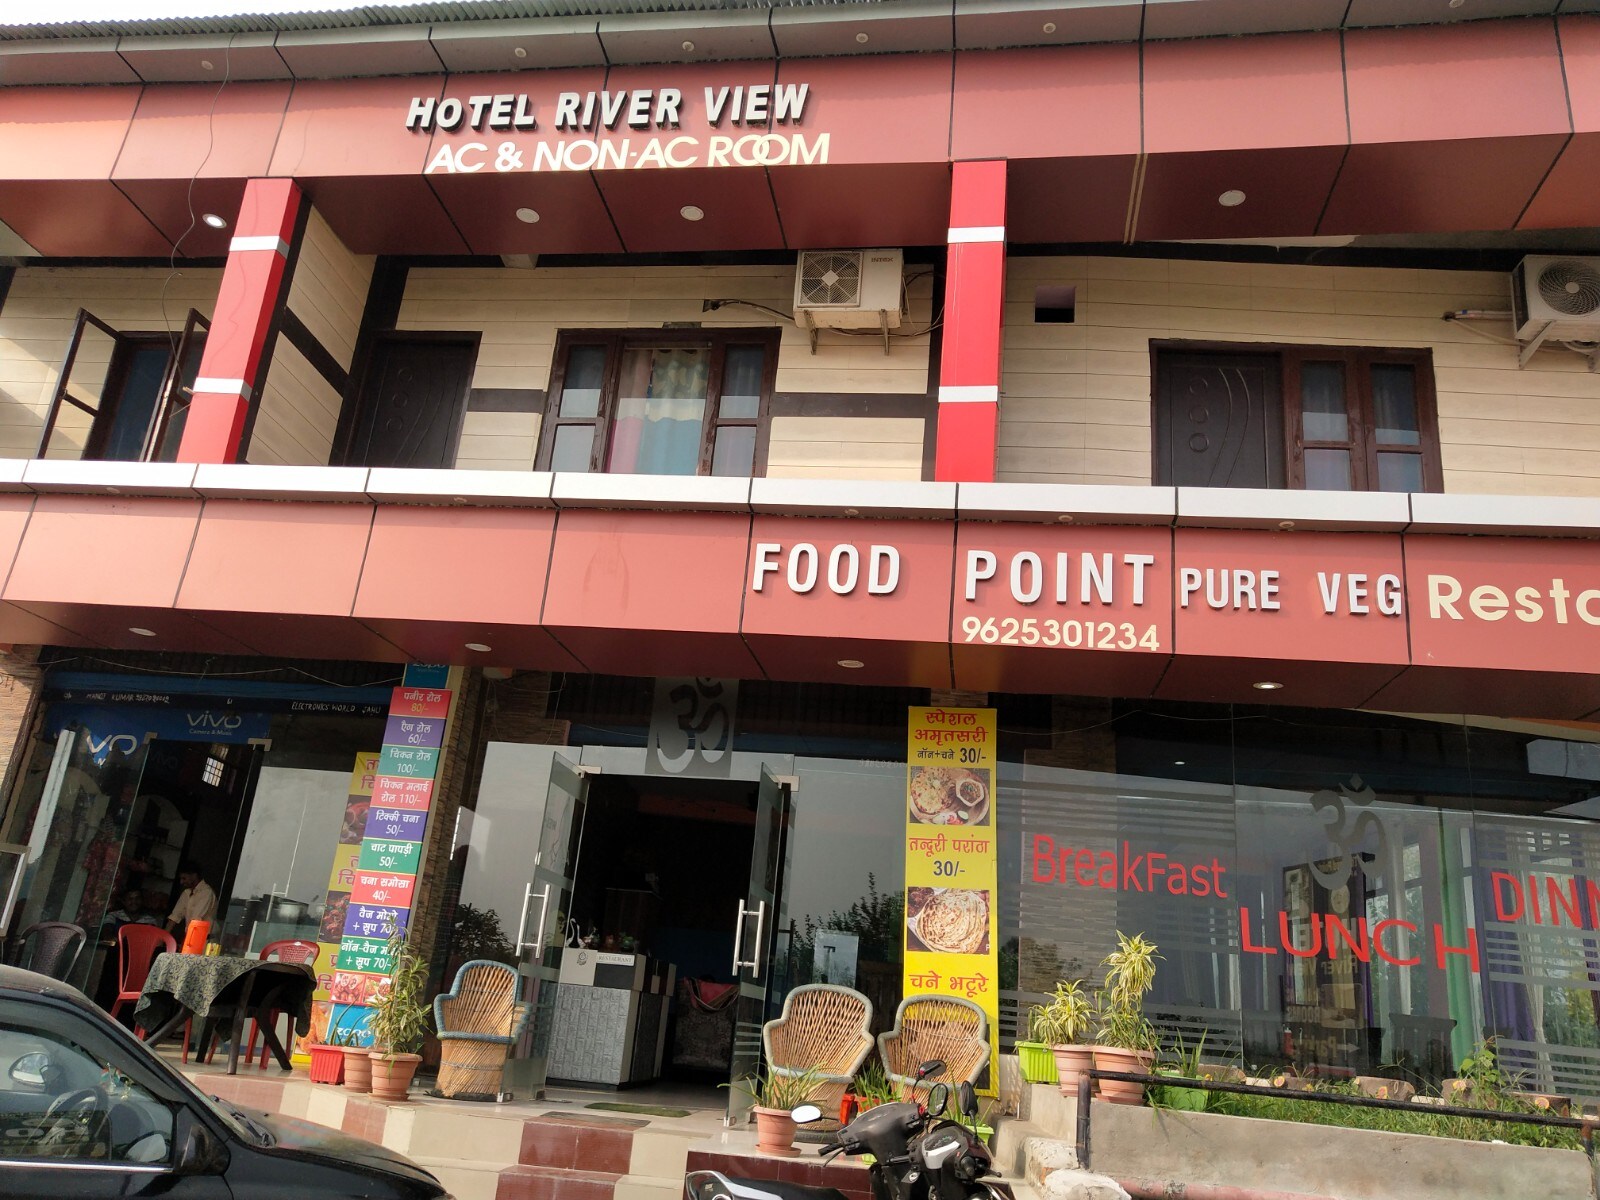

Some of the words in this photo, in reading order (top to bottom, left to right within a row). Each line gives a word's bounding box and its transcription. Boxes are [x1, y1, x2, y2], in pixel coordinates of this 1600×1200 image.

[406, 94, 535, 131] HOTEL
[555, 88, 681, 130] RIVER
[704, 83, 809, 126] VIEW
[426, 143, 488, 173] AC
[494, 141, 523, 171] &
[533, 137, 699, 170] NON-AC
[708, 133, 830, 166] ROOM
[752, 543, 900, 595] FOOD
[965, 550, 1154, 605] POINT
[1180, 568, 1280, 611] PURE
[1317, 572, 1402, 616] VEG
[962, 616, 1160, 651] 9625301234
[403, 690, 425, 701] पनीर
[426, 691, 442, 703] रोल
[331, 703, 356, 713] WORLD
[925, 709, 977, 726] स्पेशल
[416, 722, 432, 733] रोल
[408, 733, 427, 745] 60/-
[914, 726, 989, 746] अमृतसरी
[389, 747, 414, 760] चिकन
[416, 749, 432, 761] रोल
[960, 747, 986, 764] 30/-
[397, 763, 419, 775] 100/-
[380, 778, 405, 790] चिकन
[406, 780, 429, 793] मलाई
[381, 791, 397, 803] रोल
[399, 794, 421, 806] 110/-
[402, 814, 420, 823] चना
[385, 824, 404, 836] 50/-
[371, 843, 387, 852] चाट
[388, 842, 413, 857] पापड़ी
[909, 833, 947, 857] तन्दूरी
[379, 856, 398, 868] 50/-
[933, 860, 965, 877] 30/-
[1032, 833, 1228, 899] BreakFast
[360, 875, 379, 886] चना
[380, 876, 411, 888] समोसा
[372, 890, 391, 902] 40/-
[1240, 907, 1482, 973] LUNCH
[908, 971, 942, 990] चने
[950, 972, 989, 998] भटूरे
